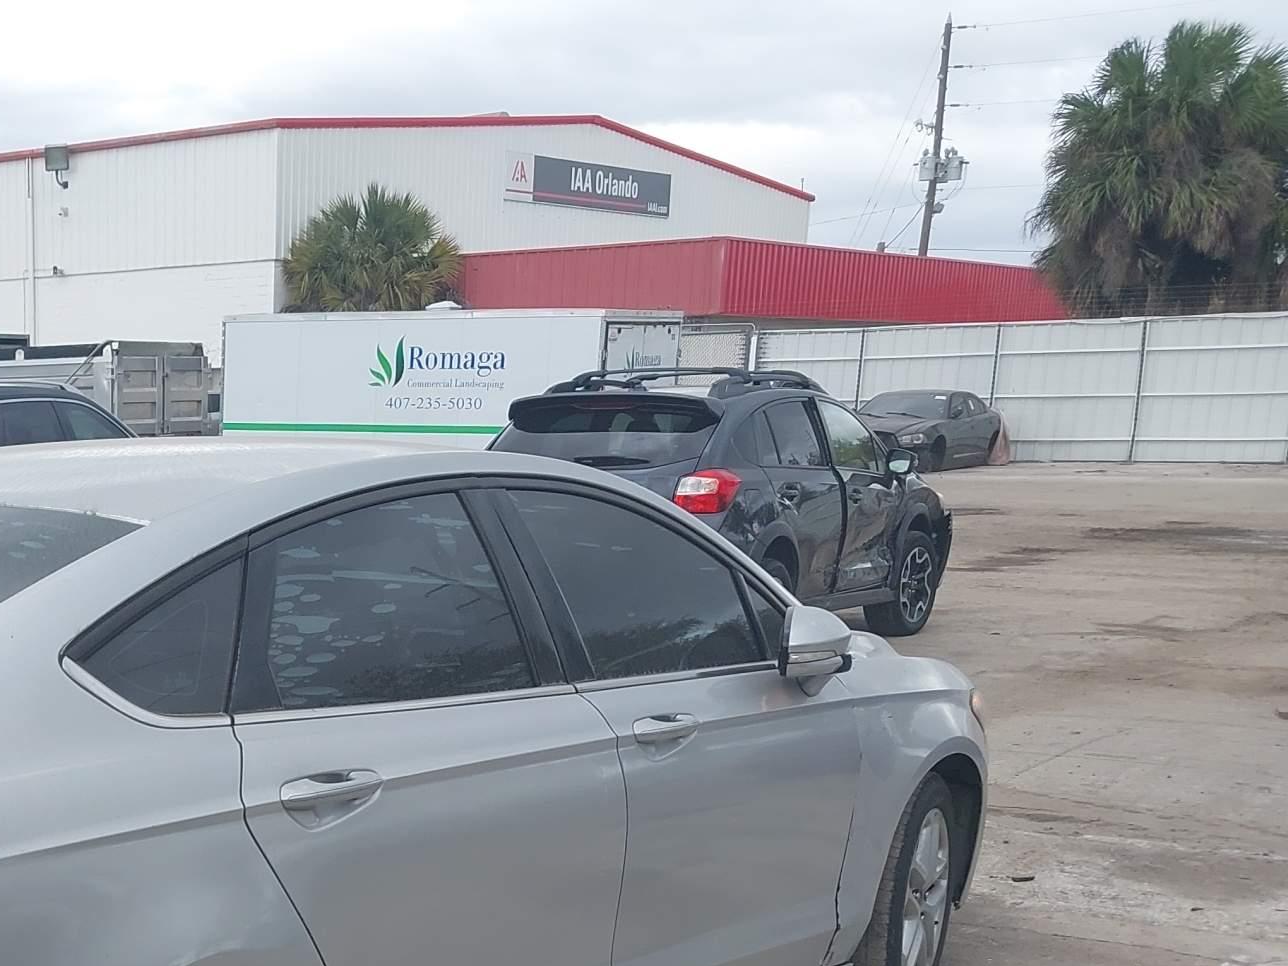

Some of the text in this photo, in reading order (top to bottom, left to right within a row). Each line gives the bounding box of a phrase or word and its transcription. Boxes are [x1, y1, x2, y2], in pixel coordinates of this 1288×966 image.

[570, 166, 639, 199] IAA Orlando
[407, 345, 506, 377] Romaga
[407, 378, 453, 388] Commercial
[385, 396, 483, 410] 407-235-5030
